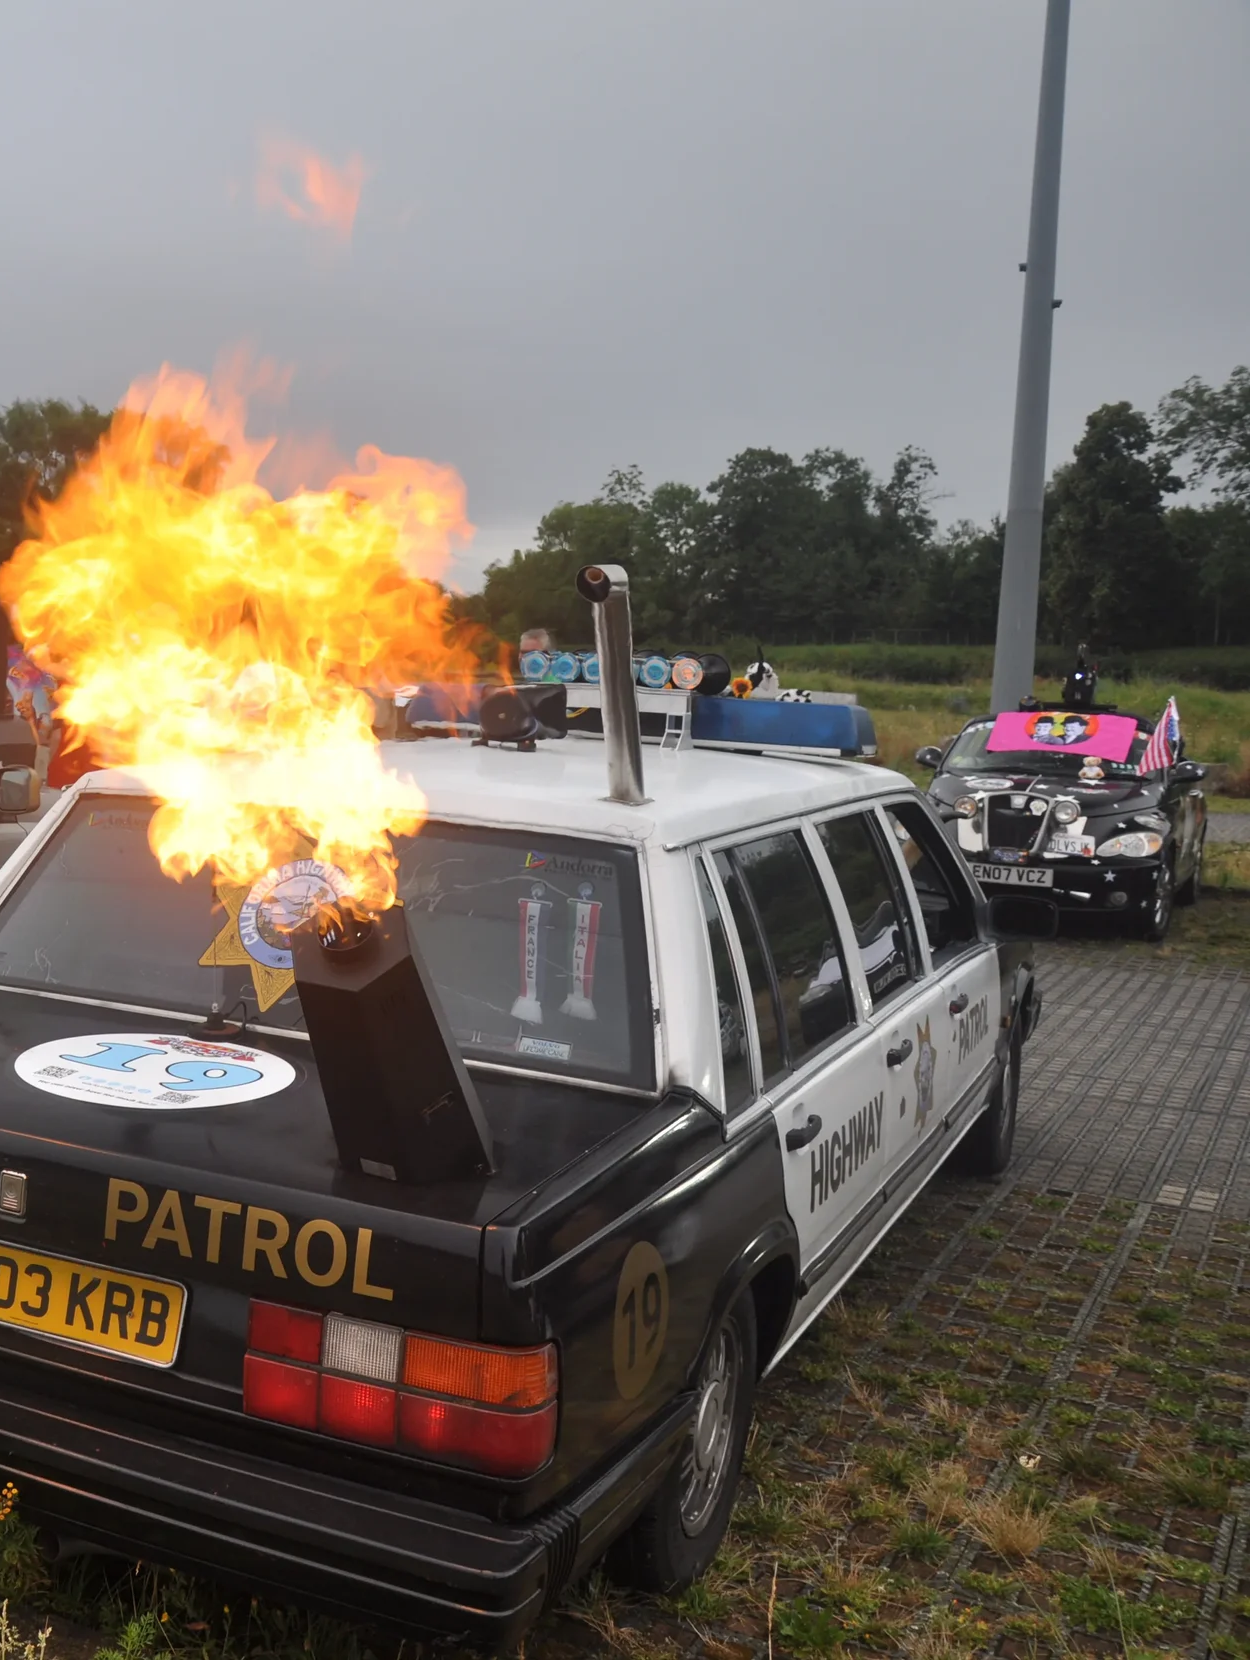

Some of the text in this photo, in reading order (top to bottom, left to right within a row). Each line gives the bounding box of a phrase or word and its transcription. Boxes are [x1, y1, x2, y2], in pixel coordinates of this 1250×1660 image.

[972, 864, 1047, 884] EN07 VCZ
[525, 914, 536, 980] FRANCE
[573, 914, 588, 984] ITALIA
[958, 995, 989, 1065] PATROL
[59, 1042, 264, 1092] 19
[810, 1091, 884, 1213] HIGHWAY
[104, 1177, 394, 1301] PATROL
[64, 1272, 171, 1347] KRB
[622, 1272, 661, 1371] 19
